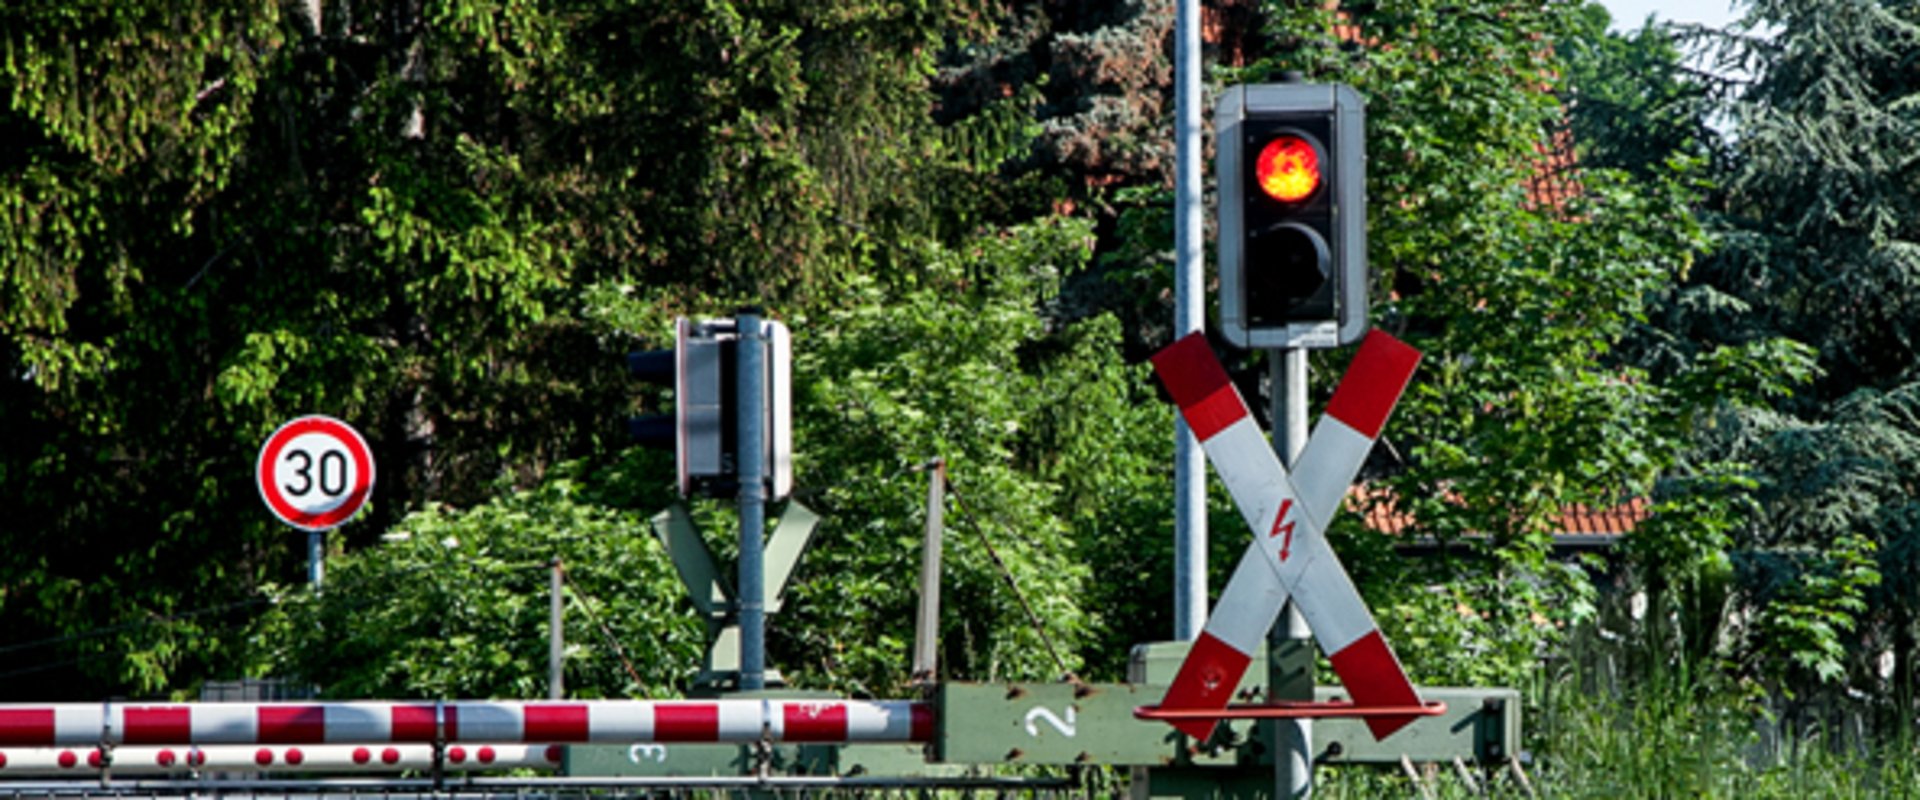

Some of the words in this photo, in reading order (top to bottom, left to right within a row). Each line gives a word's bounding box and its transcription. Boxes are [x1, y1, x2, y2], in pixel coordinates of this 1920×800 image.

[285, 449, 347, 497] 30
[1025, 706, 1076, 736] 2
[629, 743, 666, 763] 3
